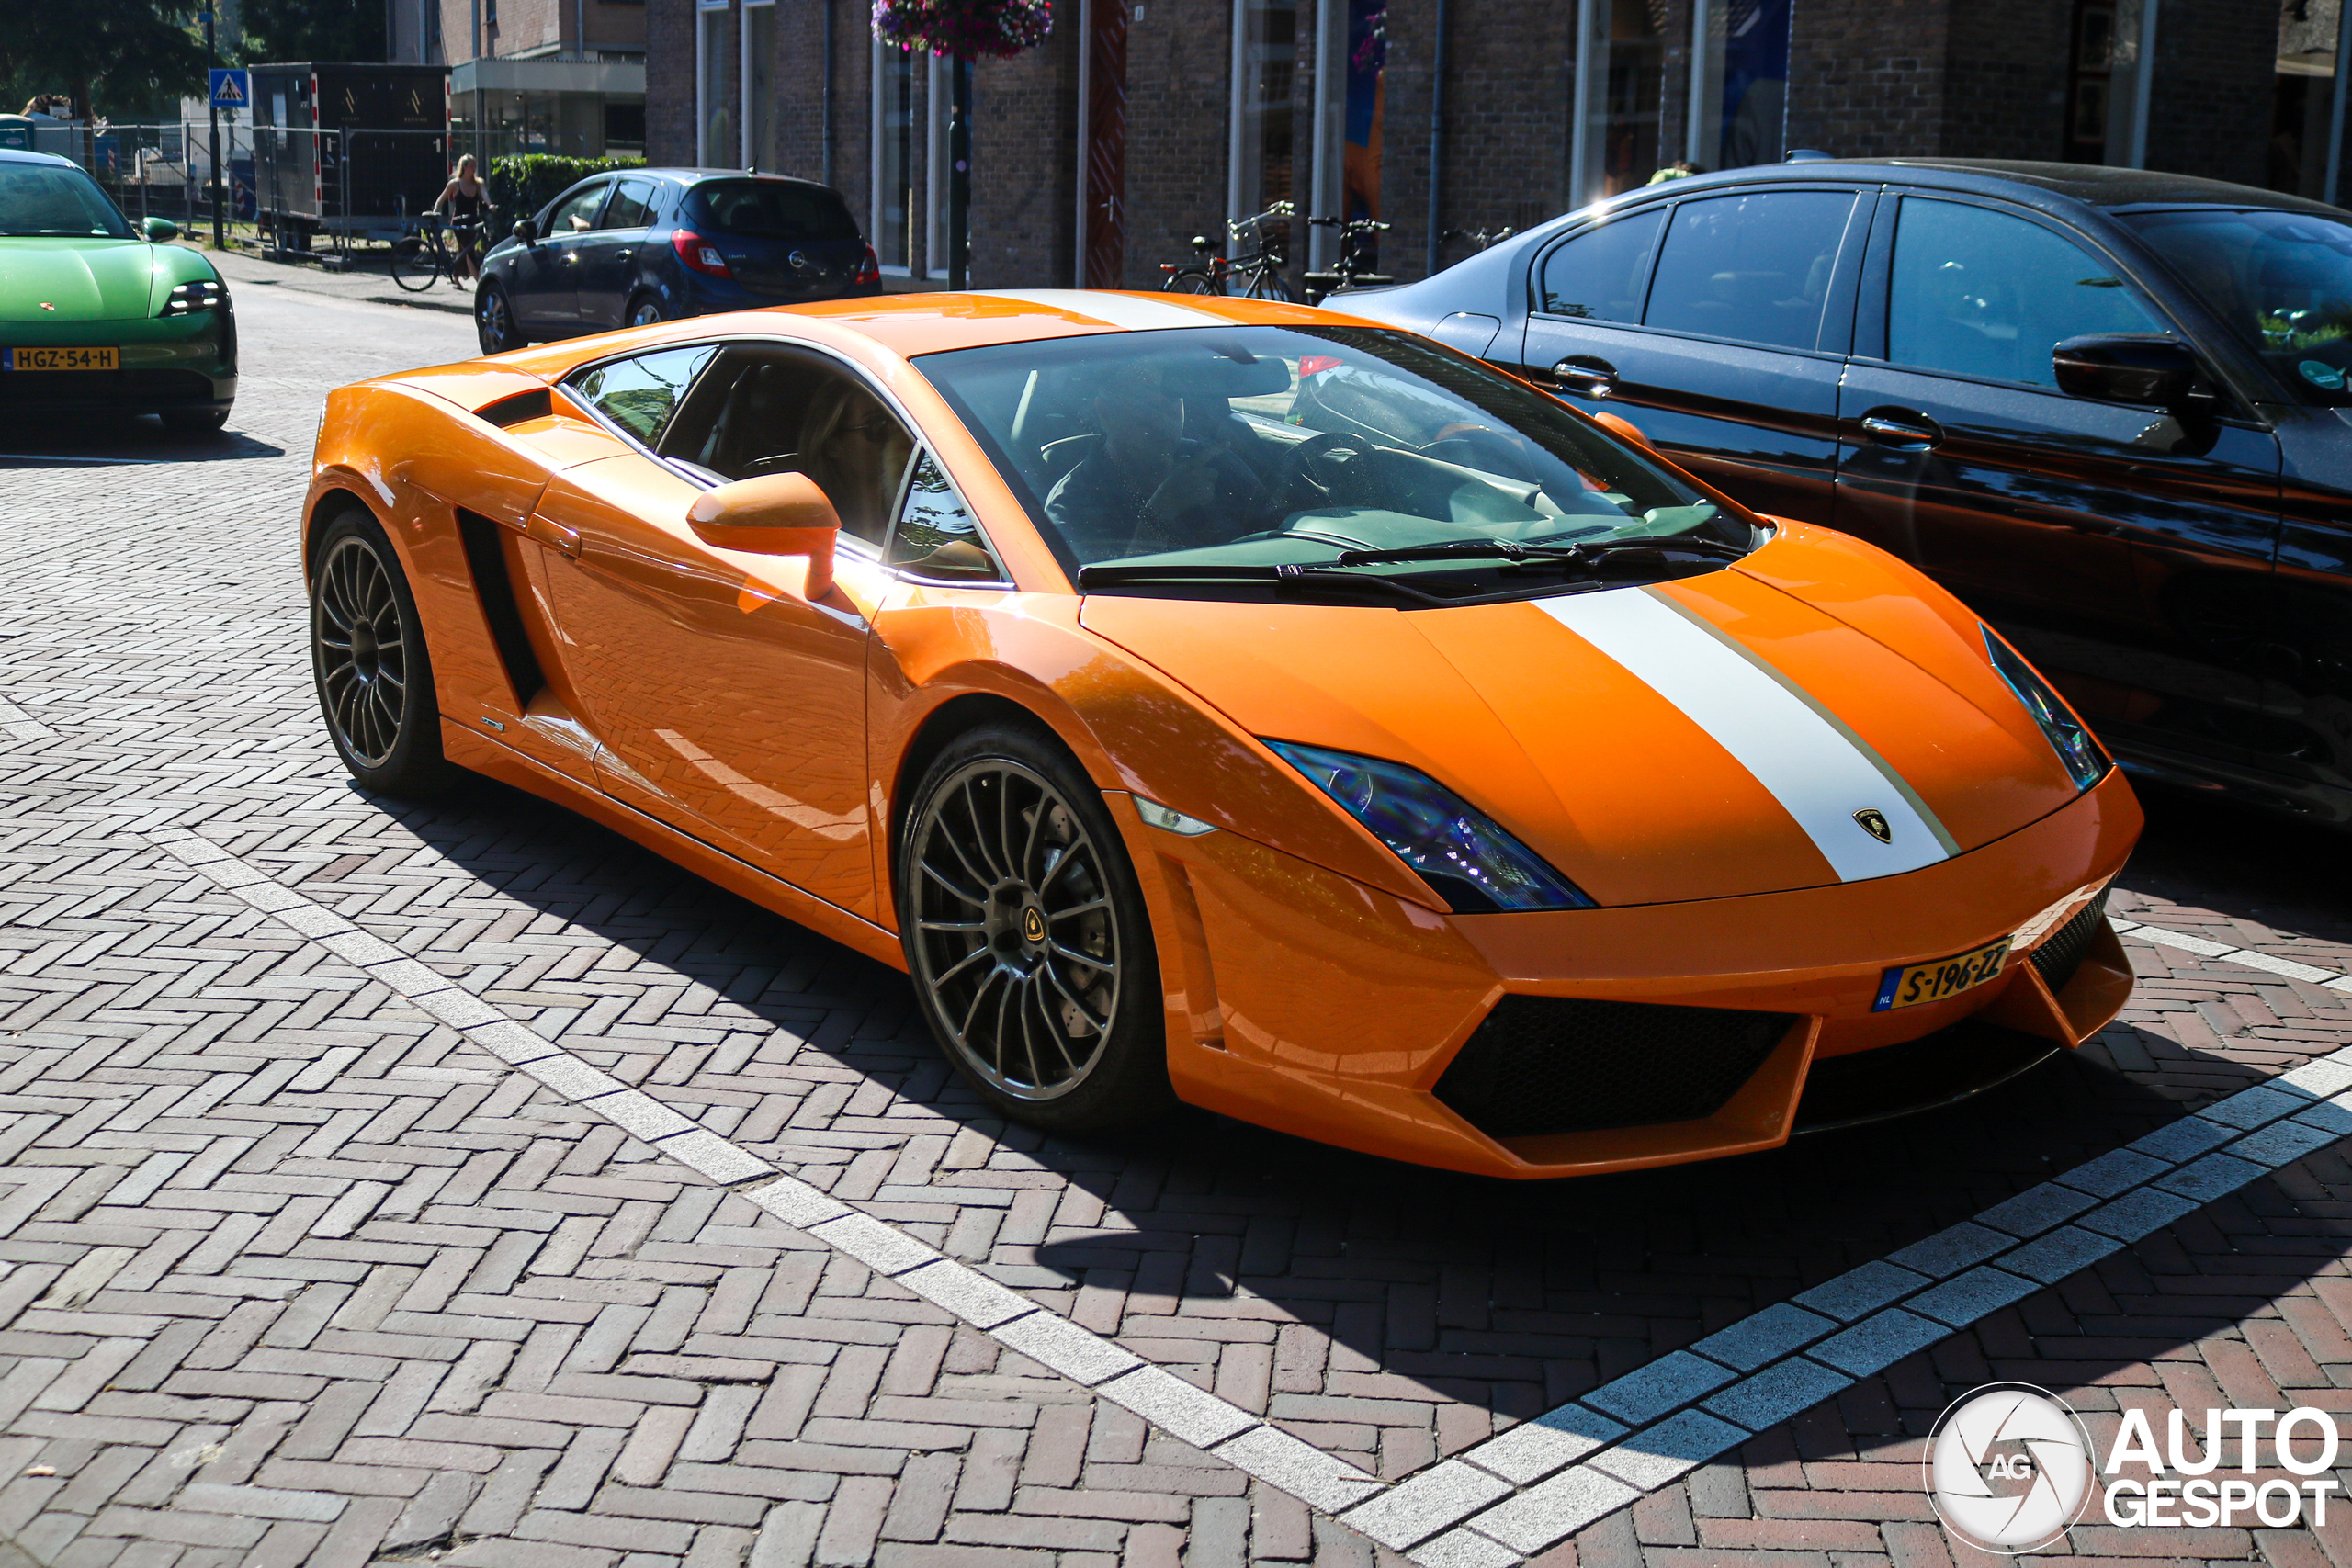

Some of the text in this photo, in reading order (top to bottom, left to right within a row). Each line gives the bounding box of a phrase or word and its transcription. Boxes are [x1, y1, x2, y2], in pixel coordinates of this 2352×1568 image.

[18, 350, 112, 367] HGZ-54-H
[1879, 943, 2007, 1005] NL S-196-ZZ
